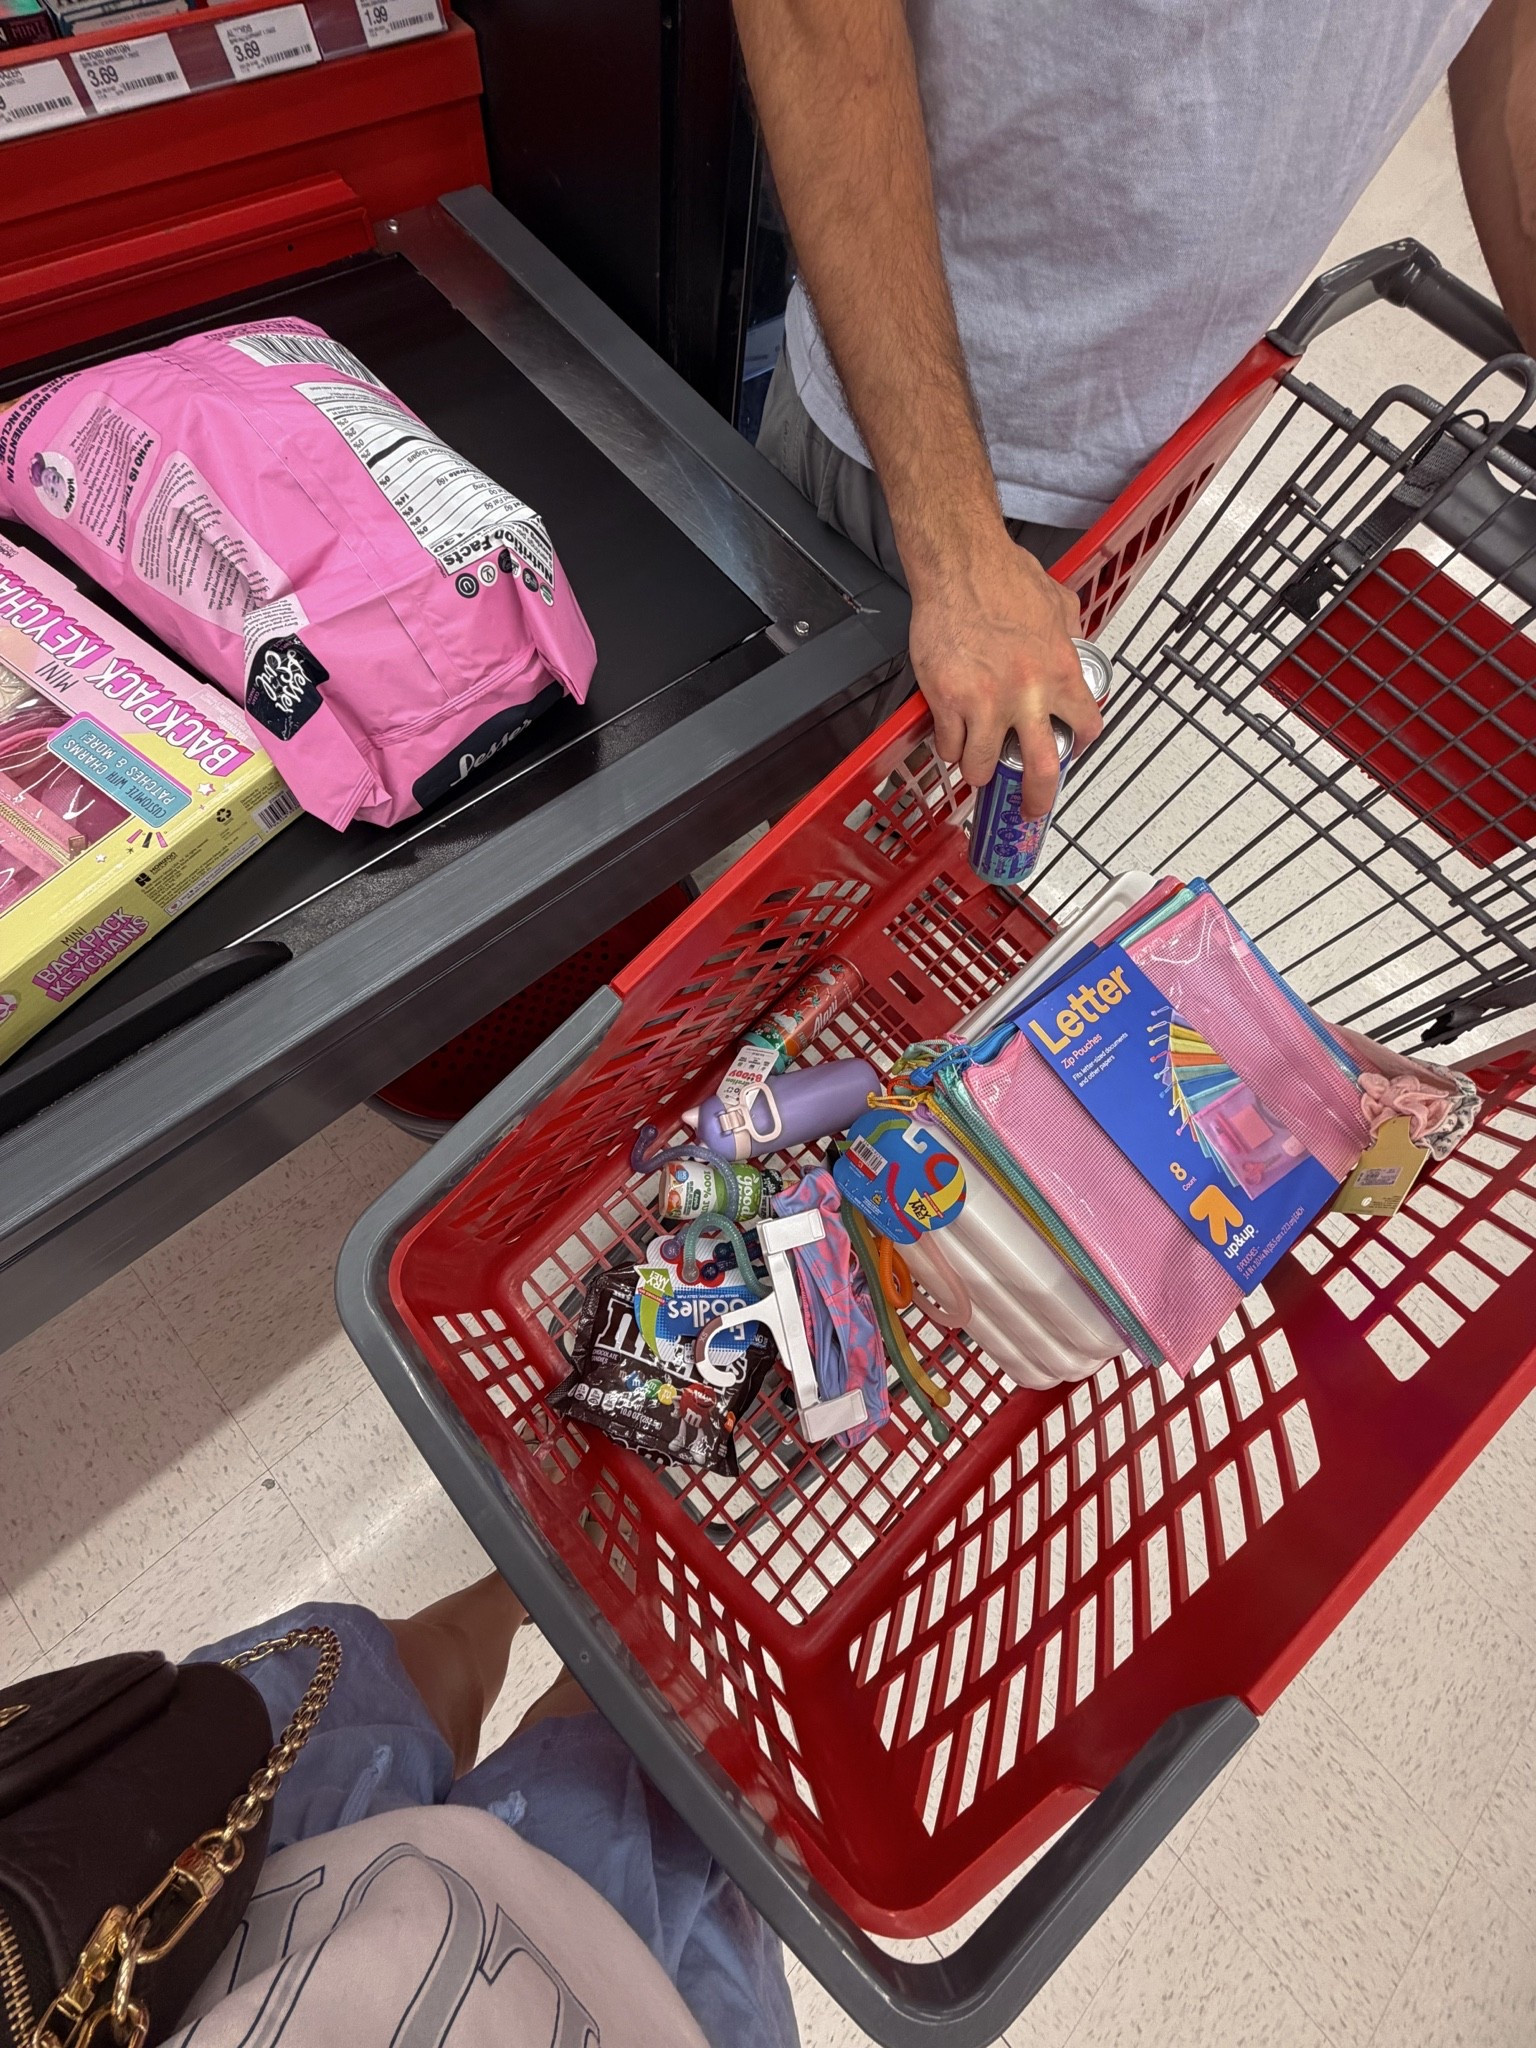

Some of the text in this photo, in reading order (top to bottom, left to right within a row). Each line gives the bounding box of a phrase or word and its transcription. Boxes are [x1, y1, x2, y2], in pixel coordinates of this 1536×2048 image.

[363, 5, 388, 26] 1.99
[233, 40, 261, 62] 3.69
[87, 65, 118, 88] 3.69
[19, 393, 40, 411] BAG
[6, 393, 51, 465] INGREDIENTS
[134, 438, 154, 467] WHO
[406, 447, 428, 463] Sugars
[6, 466, 15, 484] IN
[127, 467, 140, 483] IS
[436, 475, 448, 486] 16g
[393, 493, 411, 507] 14%
[484, 497, 503, 510] Fat 5g
[504, 503, 513, 512] 6g
[104, 523, 120, 547] Journey.
[444, 533, 498, 566] Facts
[35, 661, 80, 694] MINI
[85, 657, 244, 777] BACKPACK
[62, 733, 167, 820] CUSTOMIZE WITH CHARMS,
[78, 730, 176, 805] PATCHES & MORE!
[35, 908, 133, 984] BACKPACK
[61, 926, 88, 947] MINI
[49, 915, 149, 998] KEYCHAINS
[1028, 965, 1132, 1055] Letter
[1061, 1032, 1103, 1070] Zip Pouches
[1073, 1031, 1129, 1080] Fits letter-sized documents
[1078, 1055, 1116, 1087] and other papers
[1168, 1161, 1187, 1182] 8
[703, 1171, 711, 1198] 100%
[737, 1175, 754, 1215] good
[1181, 1176, 1198, 1191] Count
[915, 1198, 932, 1219] TRY
[1293, 1205, 1305, 1220] EACH
[1223, 1223, 1256, 1259] up&up
[1239, 1246, 1259, 1269] POUCHES
[593, 1348, 618, 1360] CHOCOLATE
